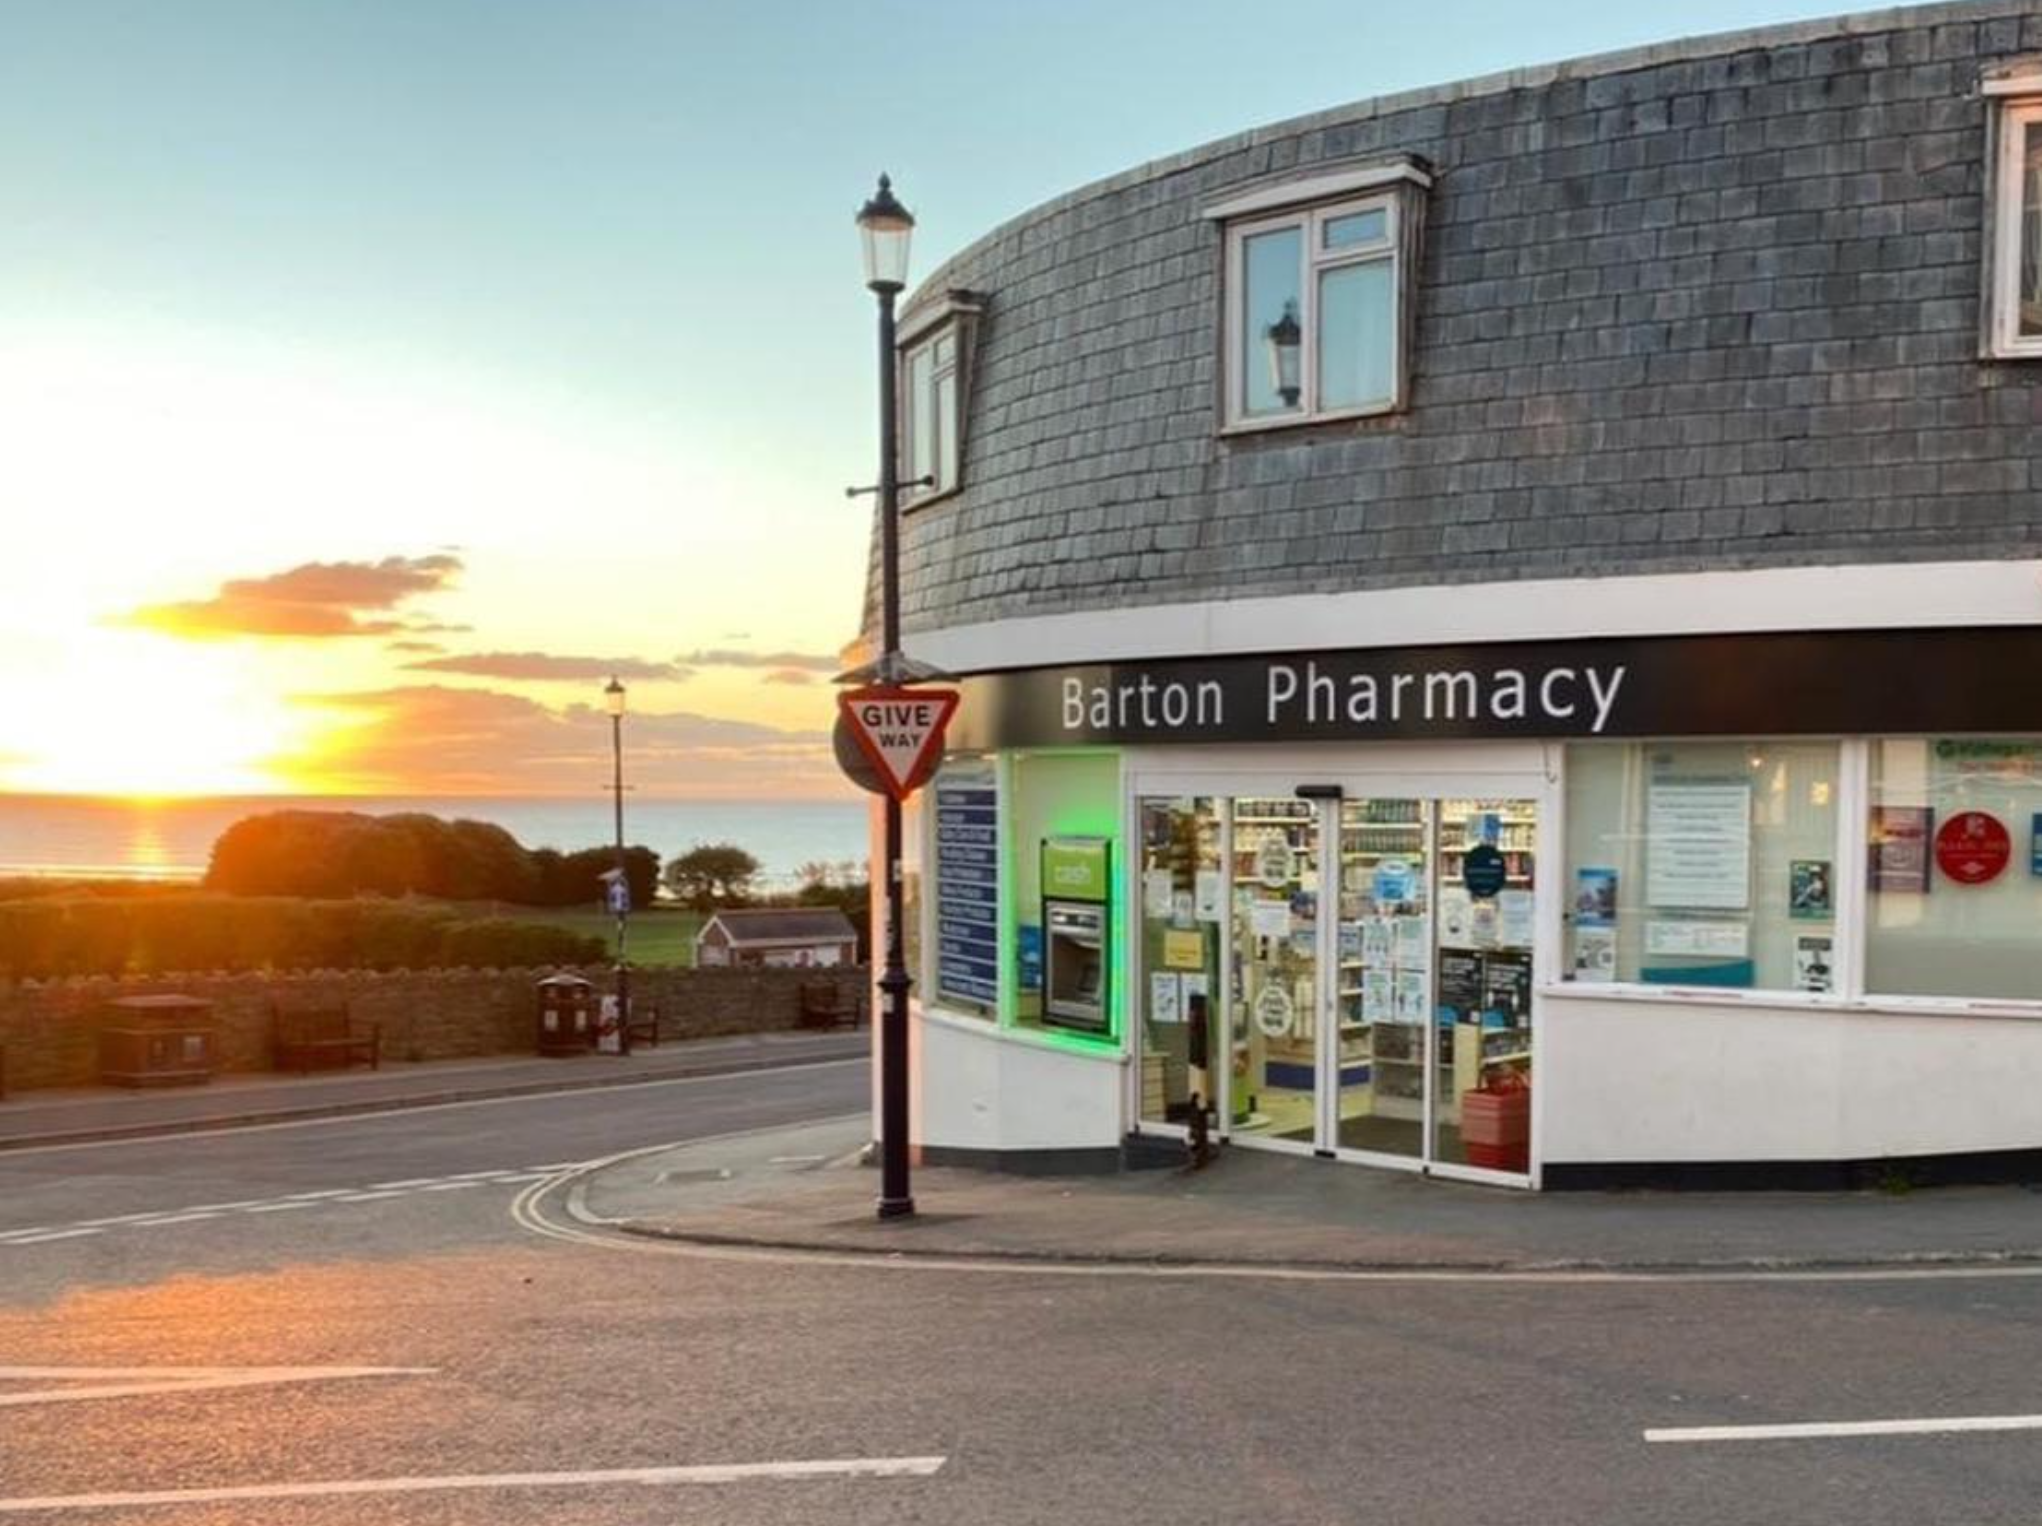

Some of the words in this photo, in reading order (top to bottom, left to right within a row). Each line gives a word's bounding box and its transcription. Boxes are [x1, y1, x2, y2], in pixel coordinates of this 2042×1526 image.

[1062, 675, 1223, 729] Barton
[1267, 661, 1625, 732] Pharmacy
[862, 705, 930, 727] GIVE
[878, 733, 921, 747] WAY
